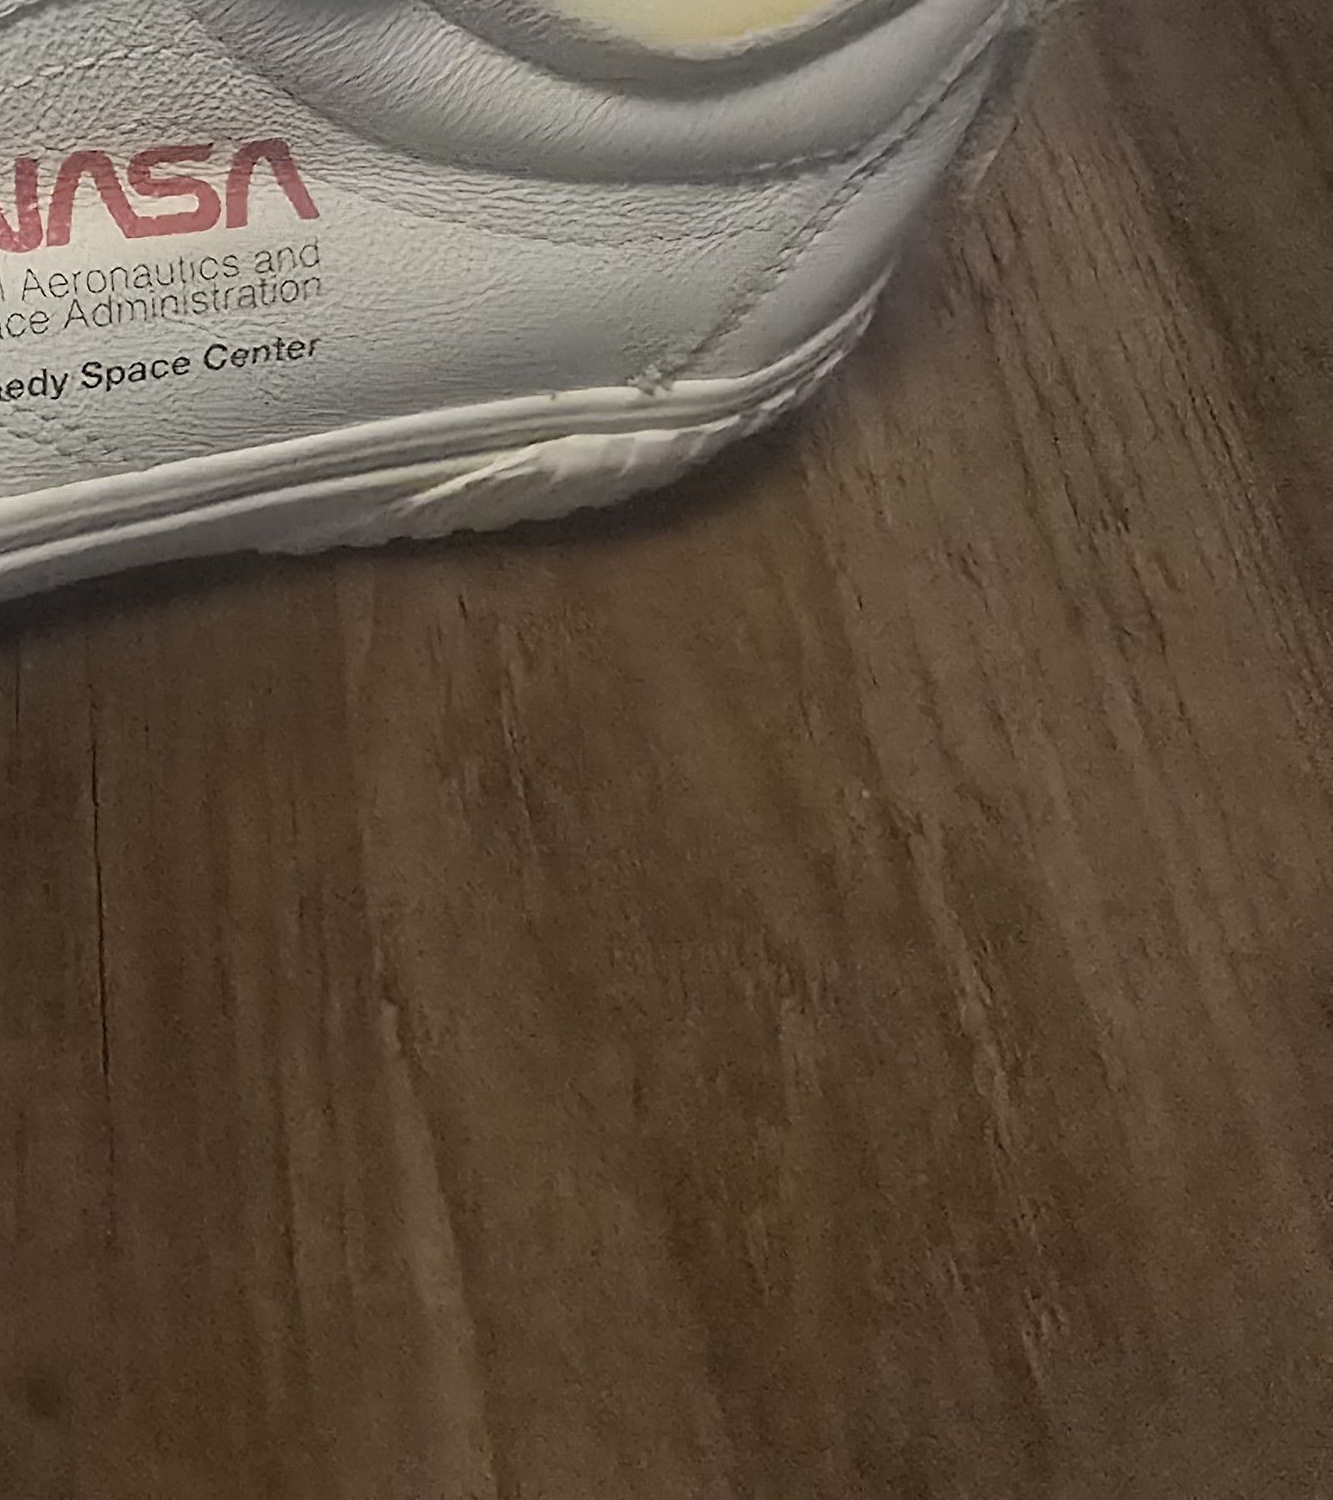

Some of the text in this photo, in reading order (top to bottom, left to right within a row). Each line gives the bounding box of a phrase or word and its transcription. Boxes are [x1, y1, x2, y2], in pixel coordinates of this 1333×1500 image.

[20, 252, 240, 301] Aeronautics
[252, 237, 322, 273] and
[63, 273, 323, 331] Administration
[80, 349, 191, 391] Space
[203, 333, 322, 372] Center
